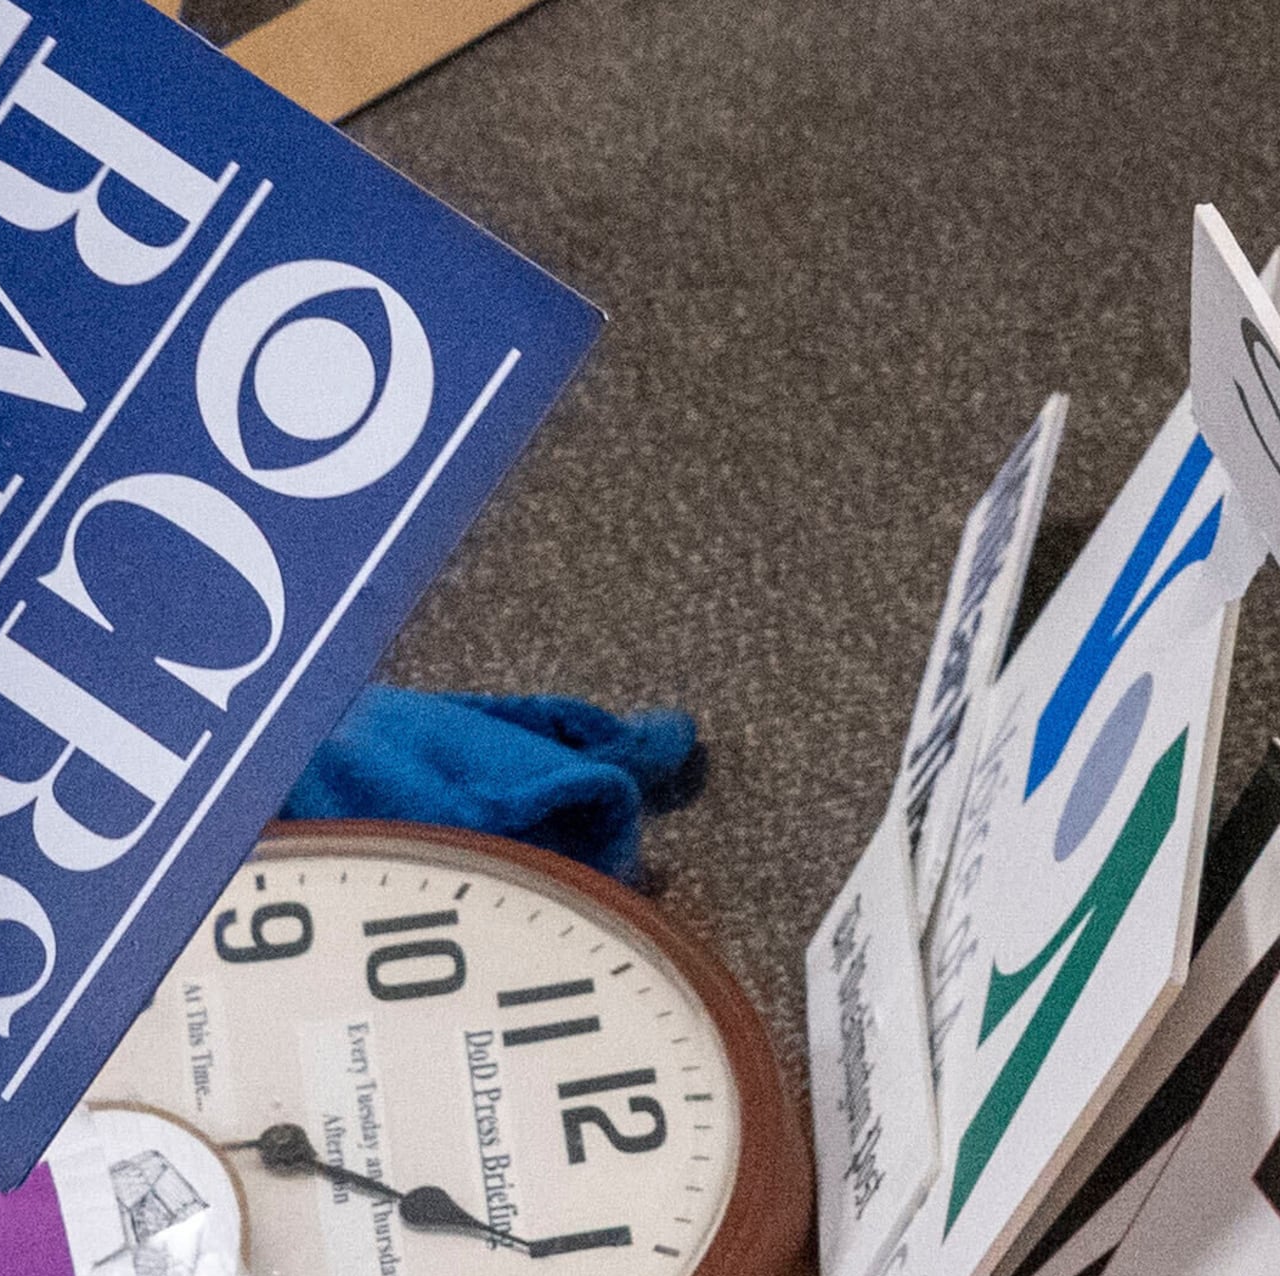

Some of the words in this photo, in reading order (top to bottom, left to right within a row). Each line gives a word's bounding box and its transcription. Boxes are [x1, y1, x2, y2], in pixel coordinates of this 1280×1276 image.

[215, 901, 314, 963] 9
[363, 909, 467, 1002] 10
[184, 984, 202, 1002] At
[497, 978, 600, 1047] 11
[187, 1007, 210, 1047] This
[347, 1021, 370, 1074] Every
[465, 1029, 498, 1080] DoD
[356, 1081, 382, 1150] Tuesday
[474, 1087, 503, 1148] Press
[557, 1068, 667, 1164] 12
[528, 1225, 632, 1258] 1
